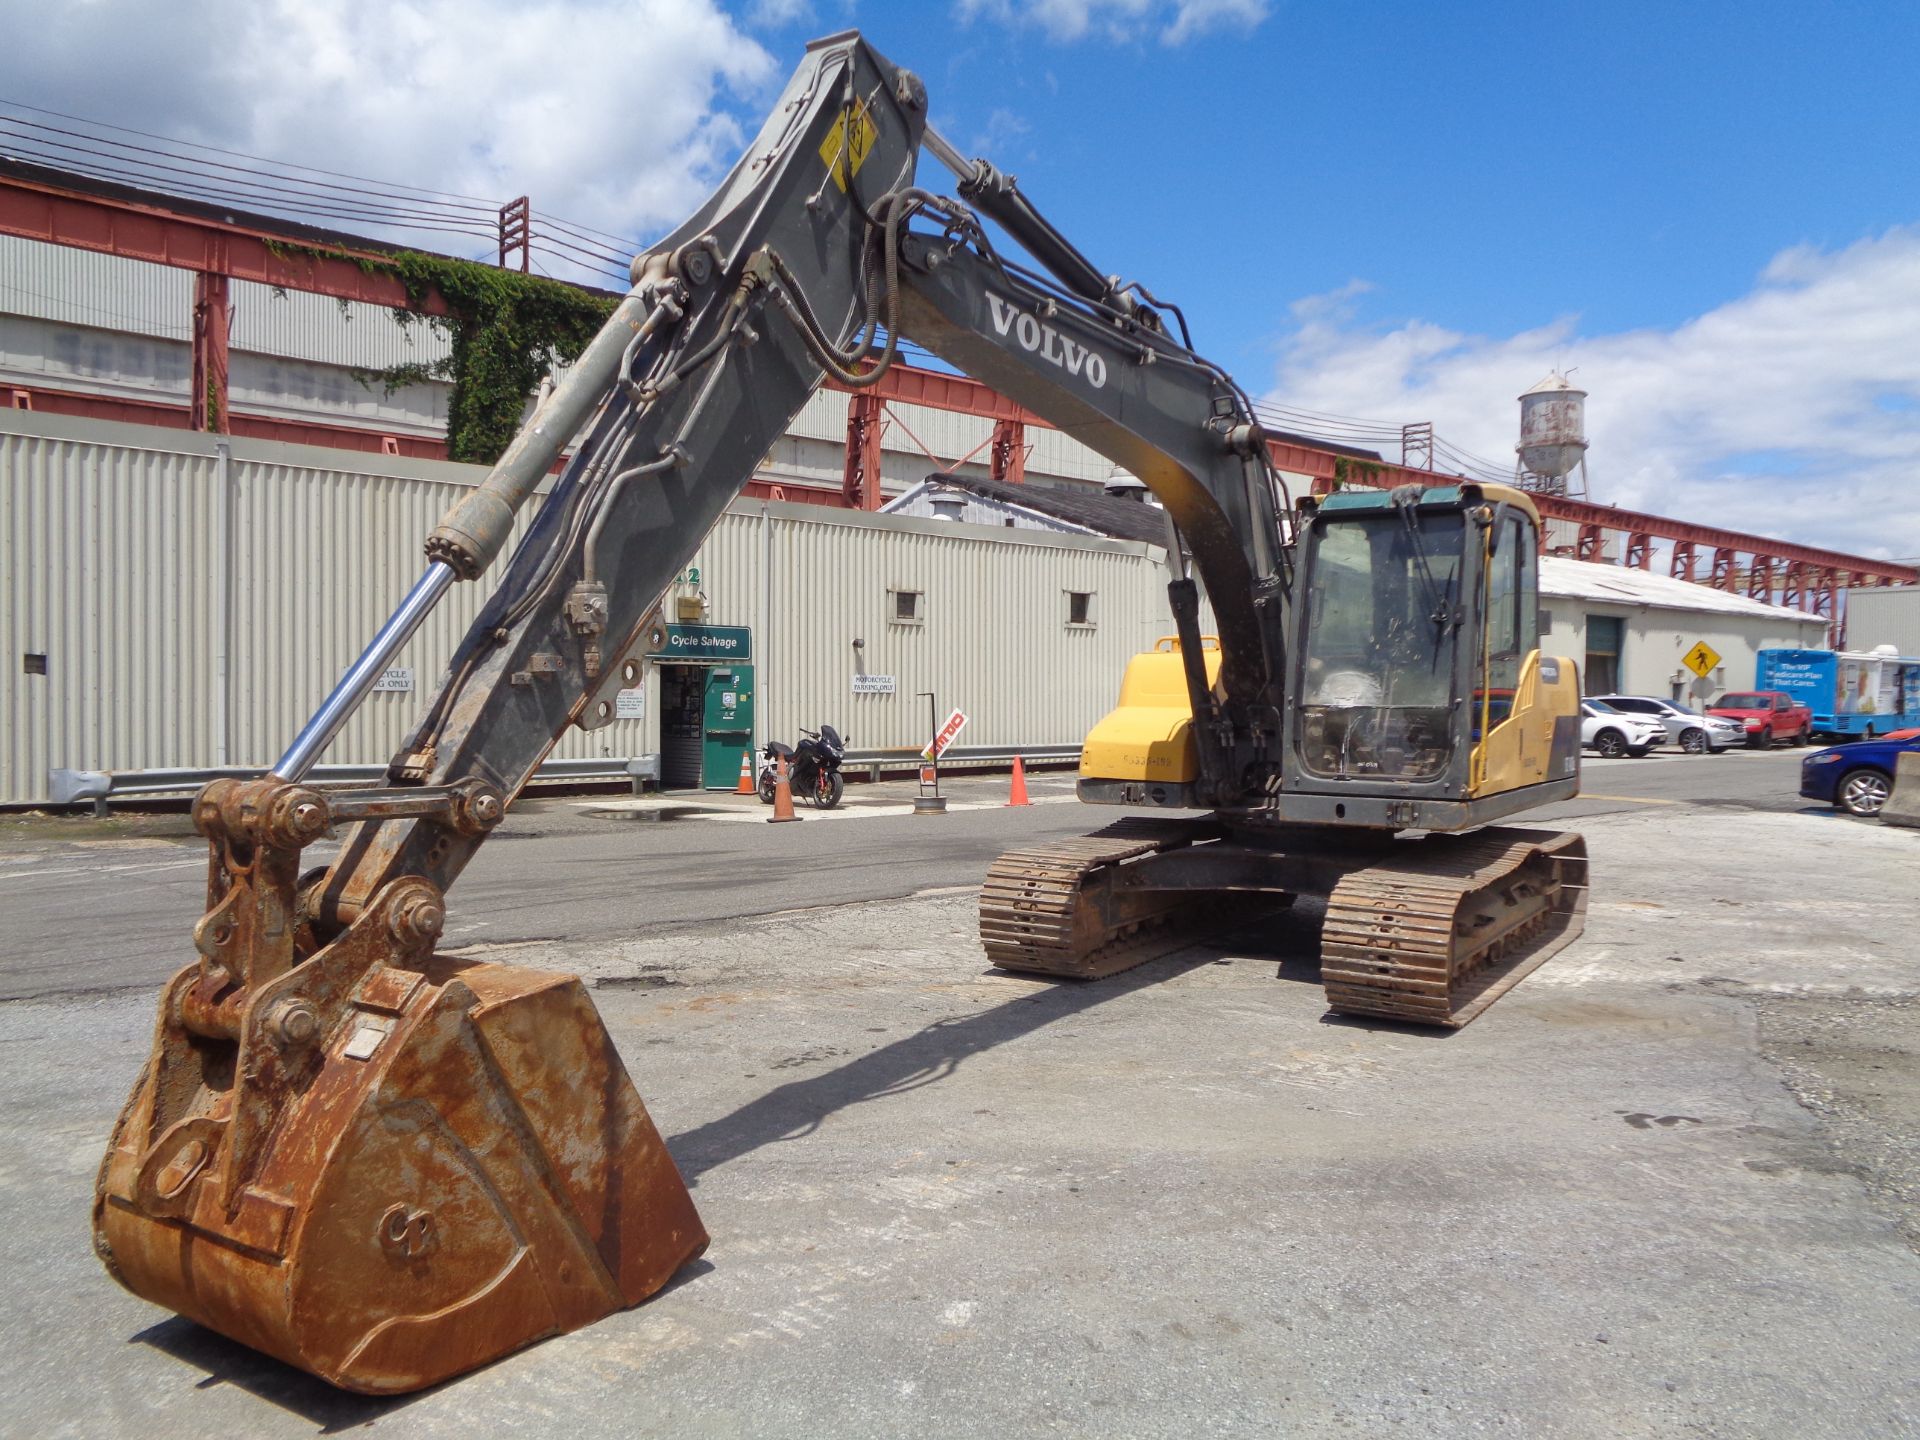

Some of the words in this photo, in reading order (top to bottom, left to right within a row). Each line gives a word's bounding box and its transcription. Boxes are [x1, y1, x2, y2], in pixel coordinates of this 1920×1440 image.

[985, 290, 1107, 389] VOLVO
[671, 635, 698, 647] Cycle
[701, 637, 737, 649] Salvage
